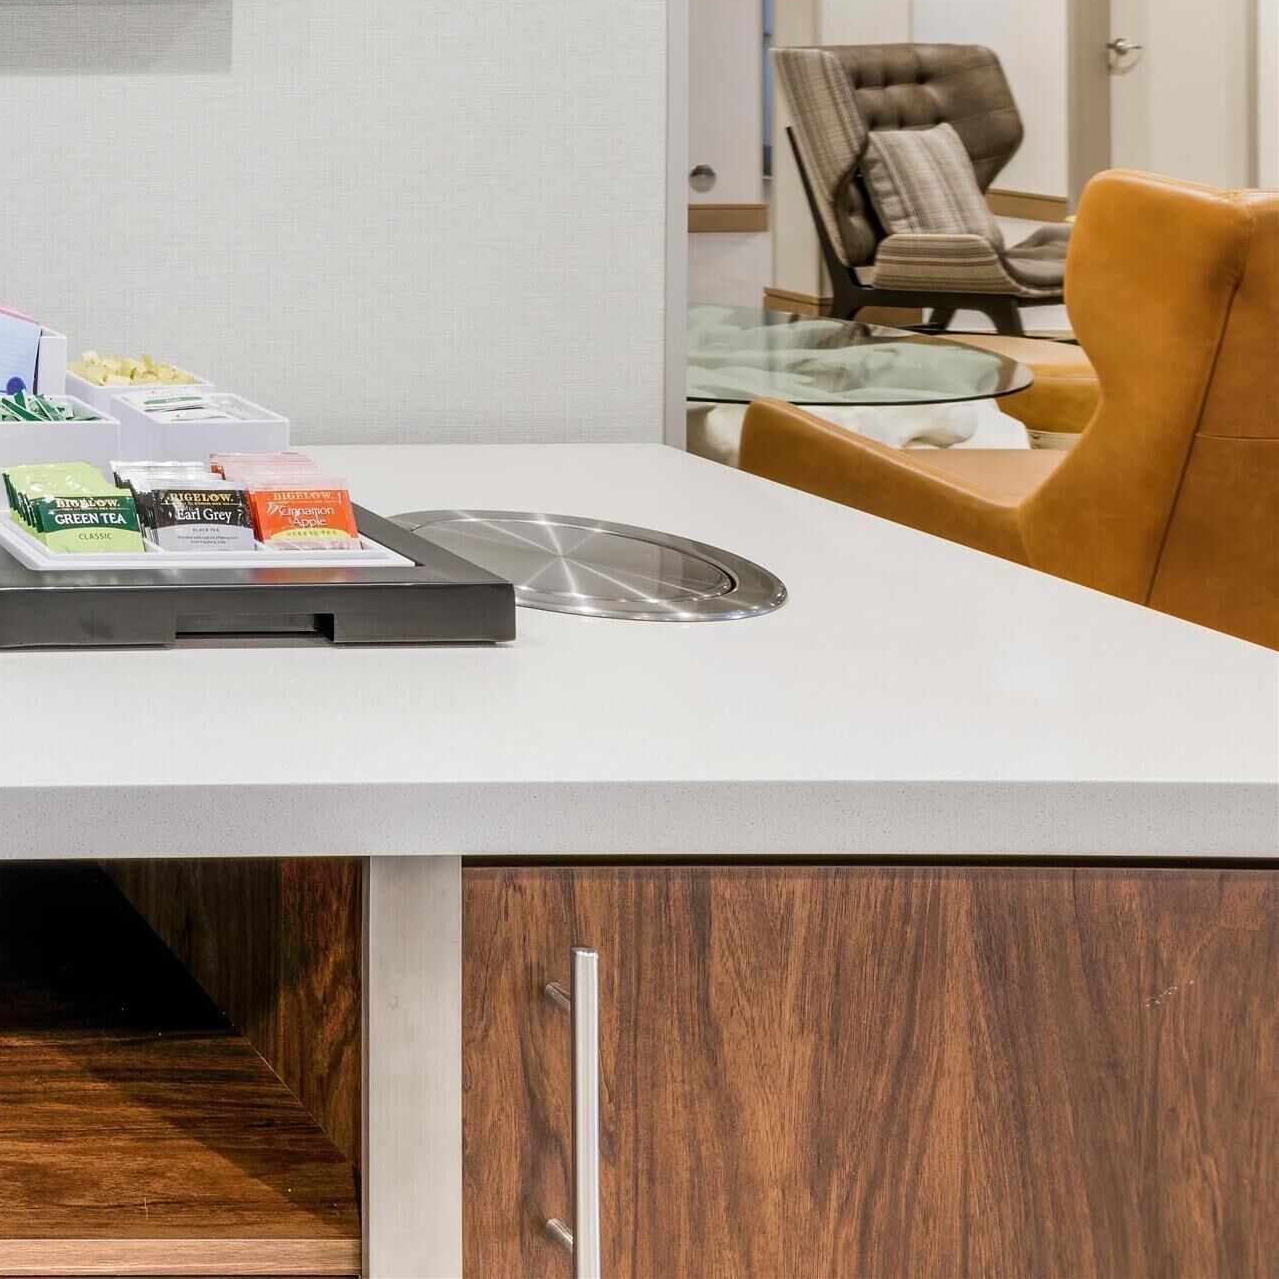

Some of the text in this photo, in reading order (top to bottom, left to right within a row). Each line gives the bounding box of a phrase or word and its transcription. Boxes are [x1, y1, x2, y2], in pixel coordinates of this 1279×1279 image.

[176, 507, 232, 524] Earl Grey
[279, 505, 335, 516] Cinnamon
[55, 513, 127, 524] GREEN TEA
[292, 516, 328, 530] Apple
[78, 532, 112, 540] CLASSIC
